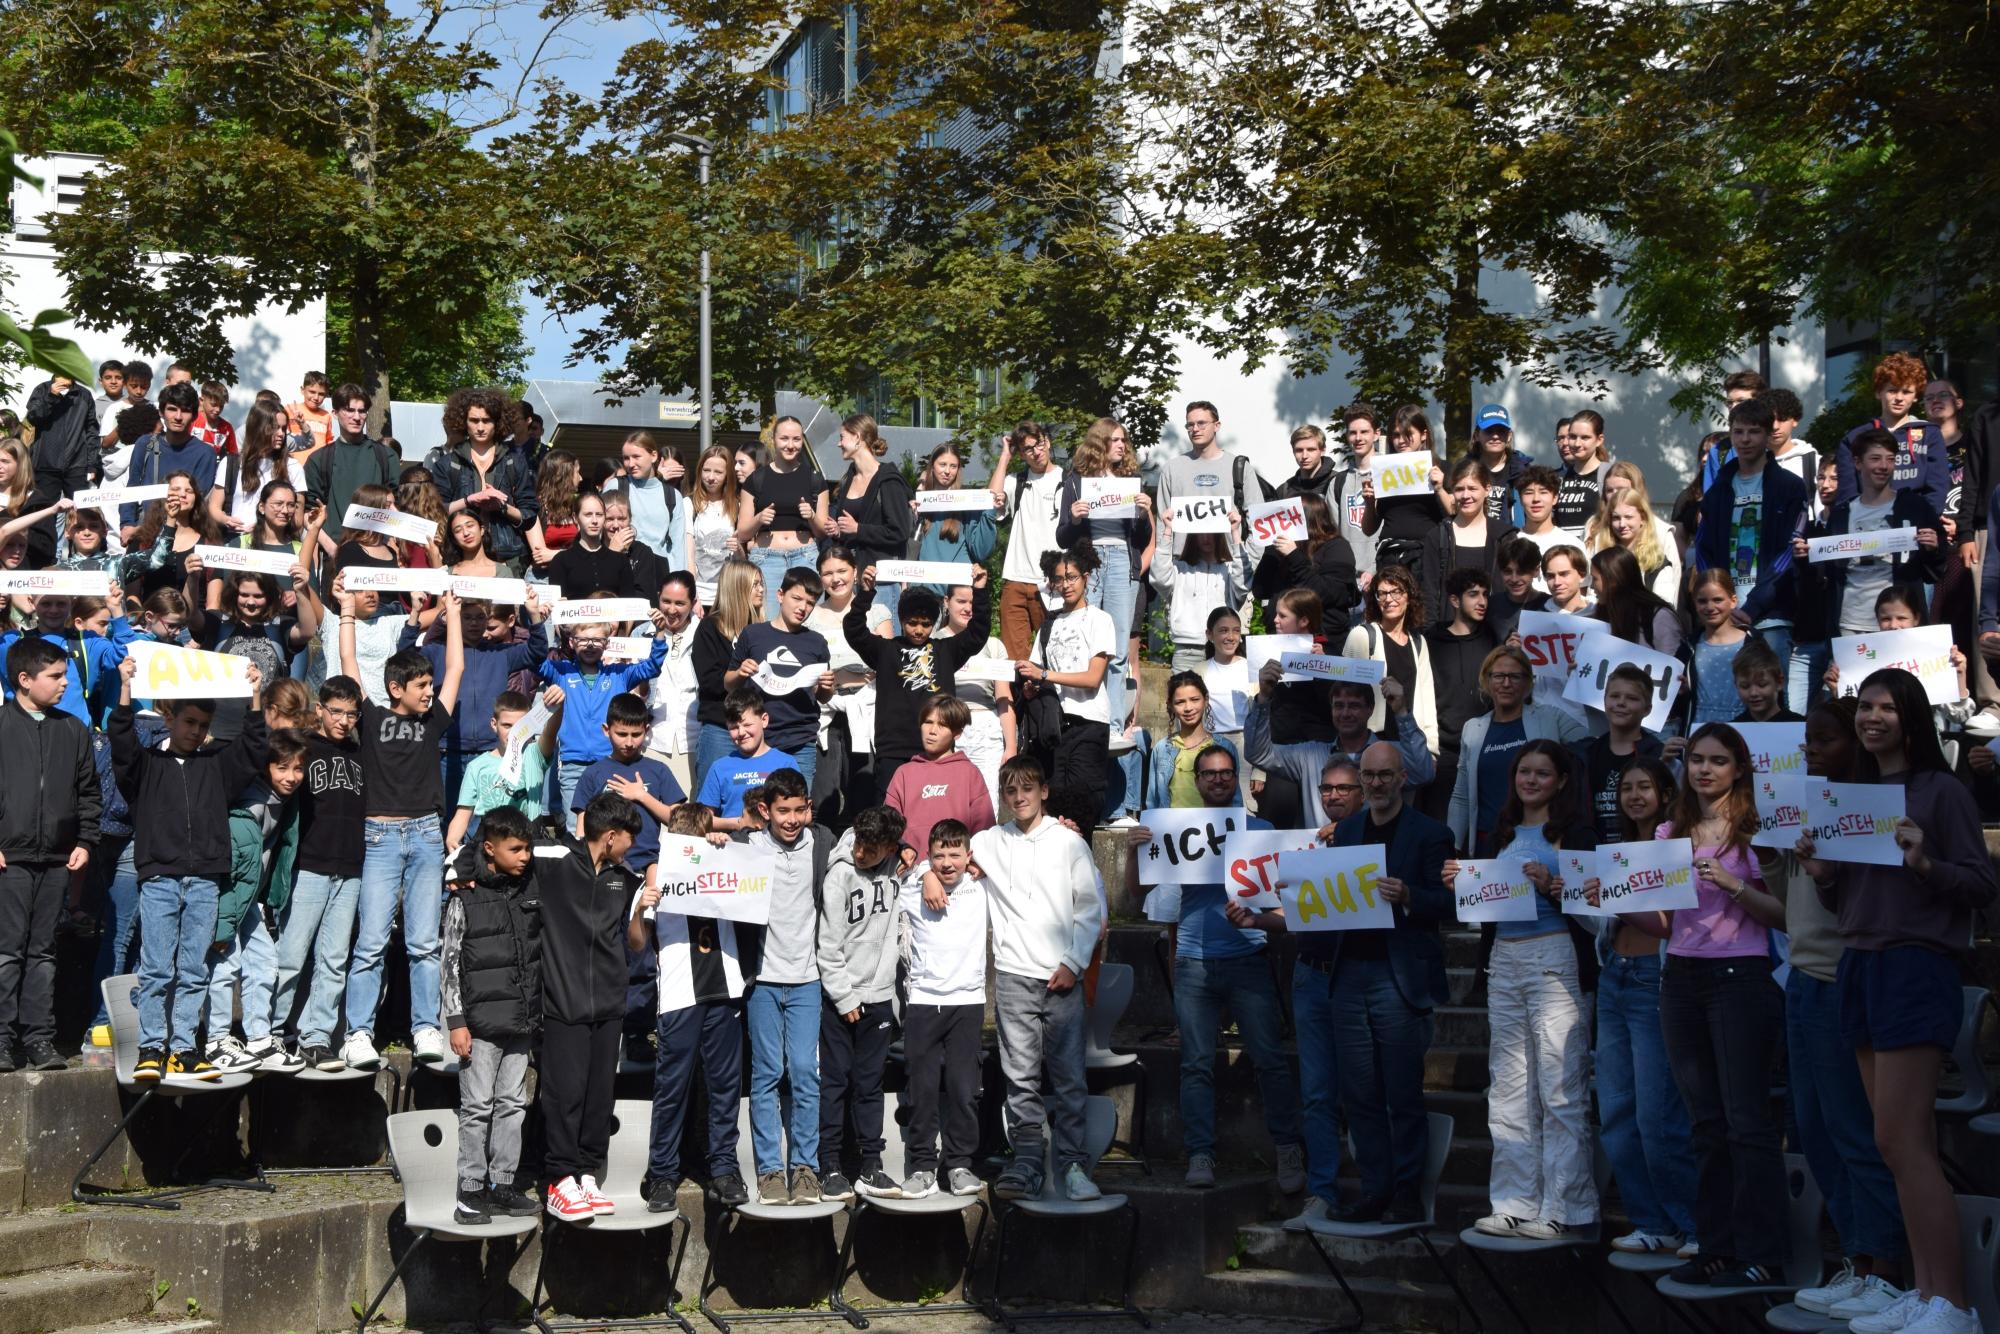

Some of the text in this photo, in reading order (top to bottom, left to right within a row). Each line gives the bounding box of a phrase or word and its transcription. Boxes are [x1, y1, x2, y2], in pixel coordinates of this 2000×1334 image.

[1381, 459, 1428, 492] AUF
[1893, 468, 1918, 480] NOU
[1176, 498, 1227, 522] #ICH
[1254, 506, 1303, 540] STEH
[1818, 539, 1880, 555] #ICHSTEHAUF
[1523, 632, 1585, 667] STE
[1288, 660, 1347, 676] #ICHSTEHAUF
[1578, 658, 1673, 702] #IH
[379, 715, 426, 743] GAP
[308, 756, 364, 796] GAP
[733, 771, 759, 781] JACK&
[1148, 817, 1235, 866] #ICH
[1811, 814, 1900, 841] #ICHSTEHAUF
[661, 872, 768, 897] #ICHSTEHAUF
[1296, 862, 1379, 923] AUF
[1459, 882, 1531, 908] #ICHSTEHAUF
[1601, 868, 1690, 901] #ICHSTEHAUF
